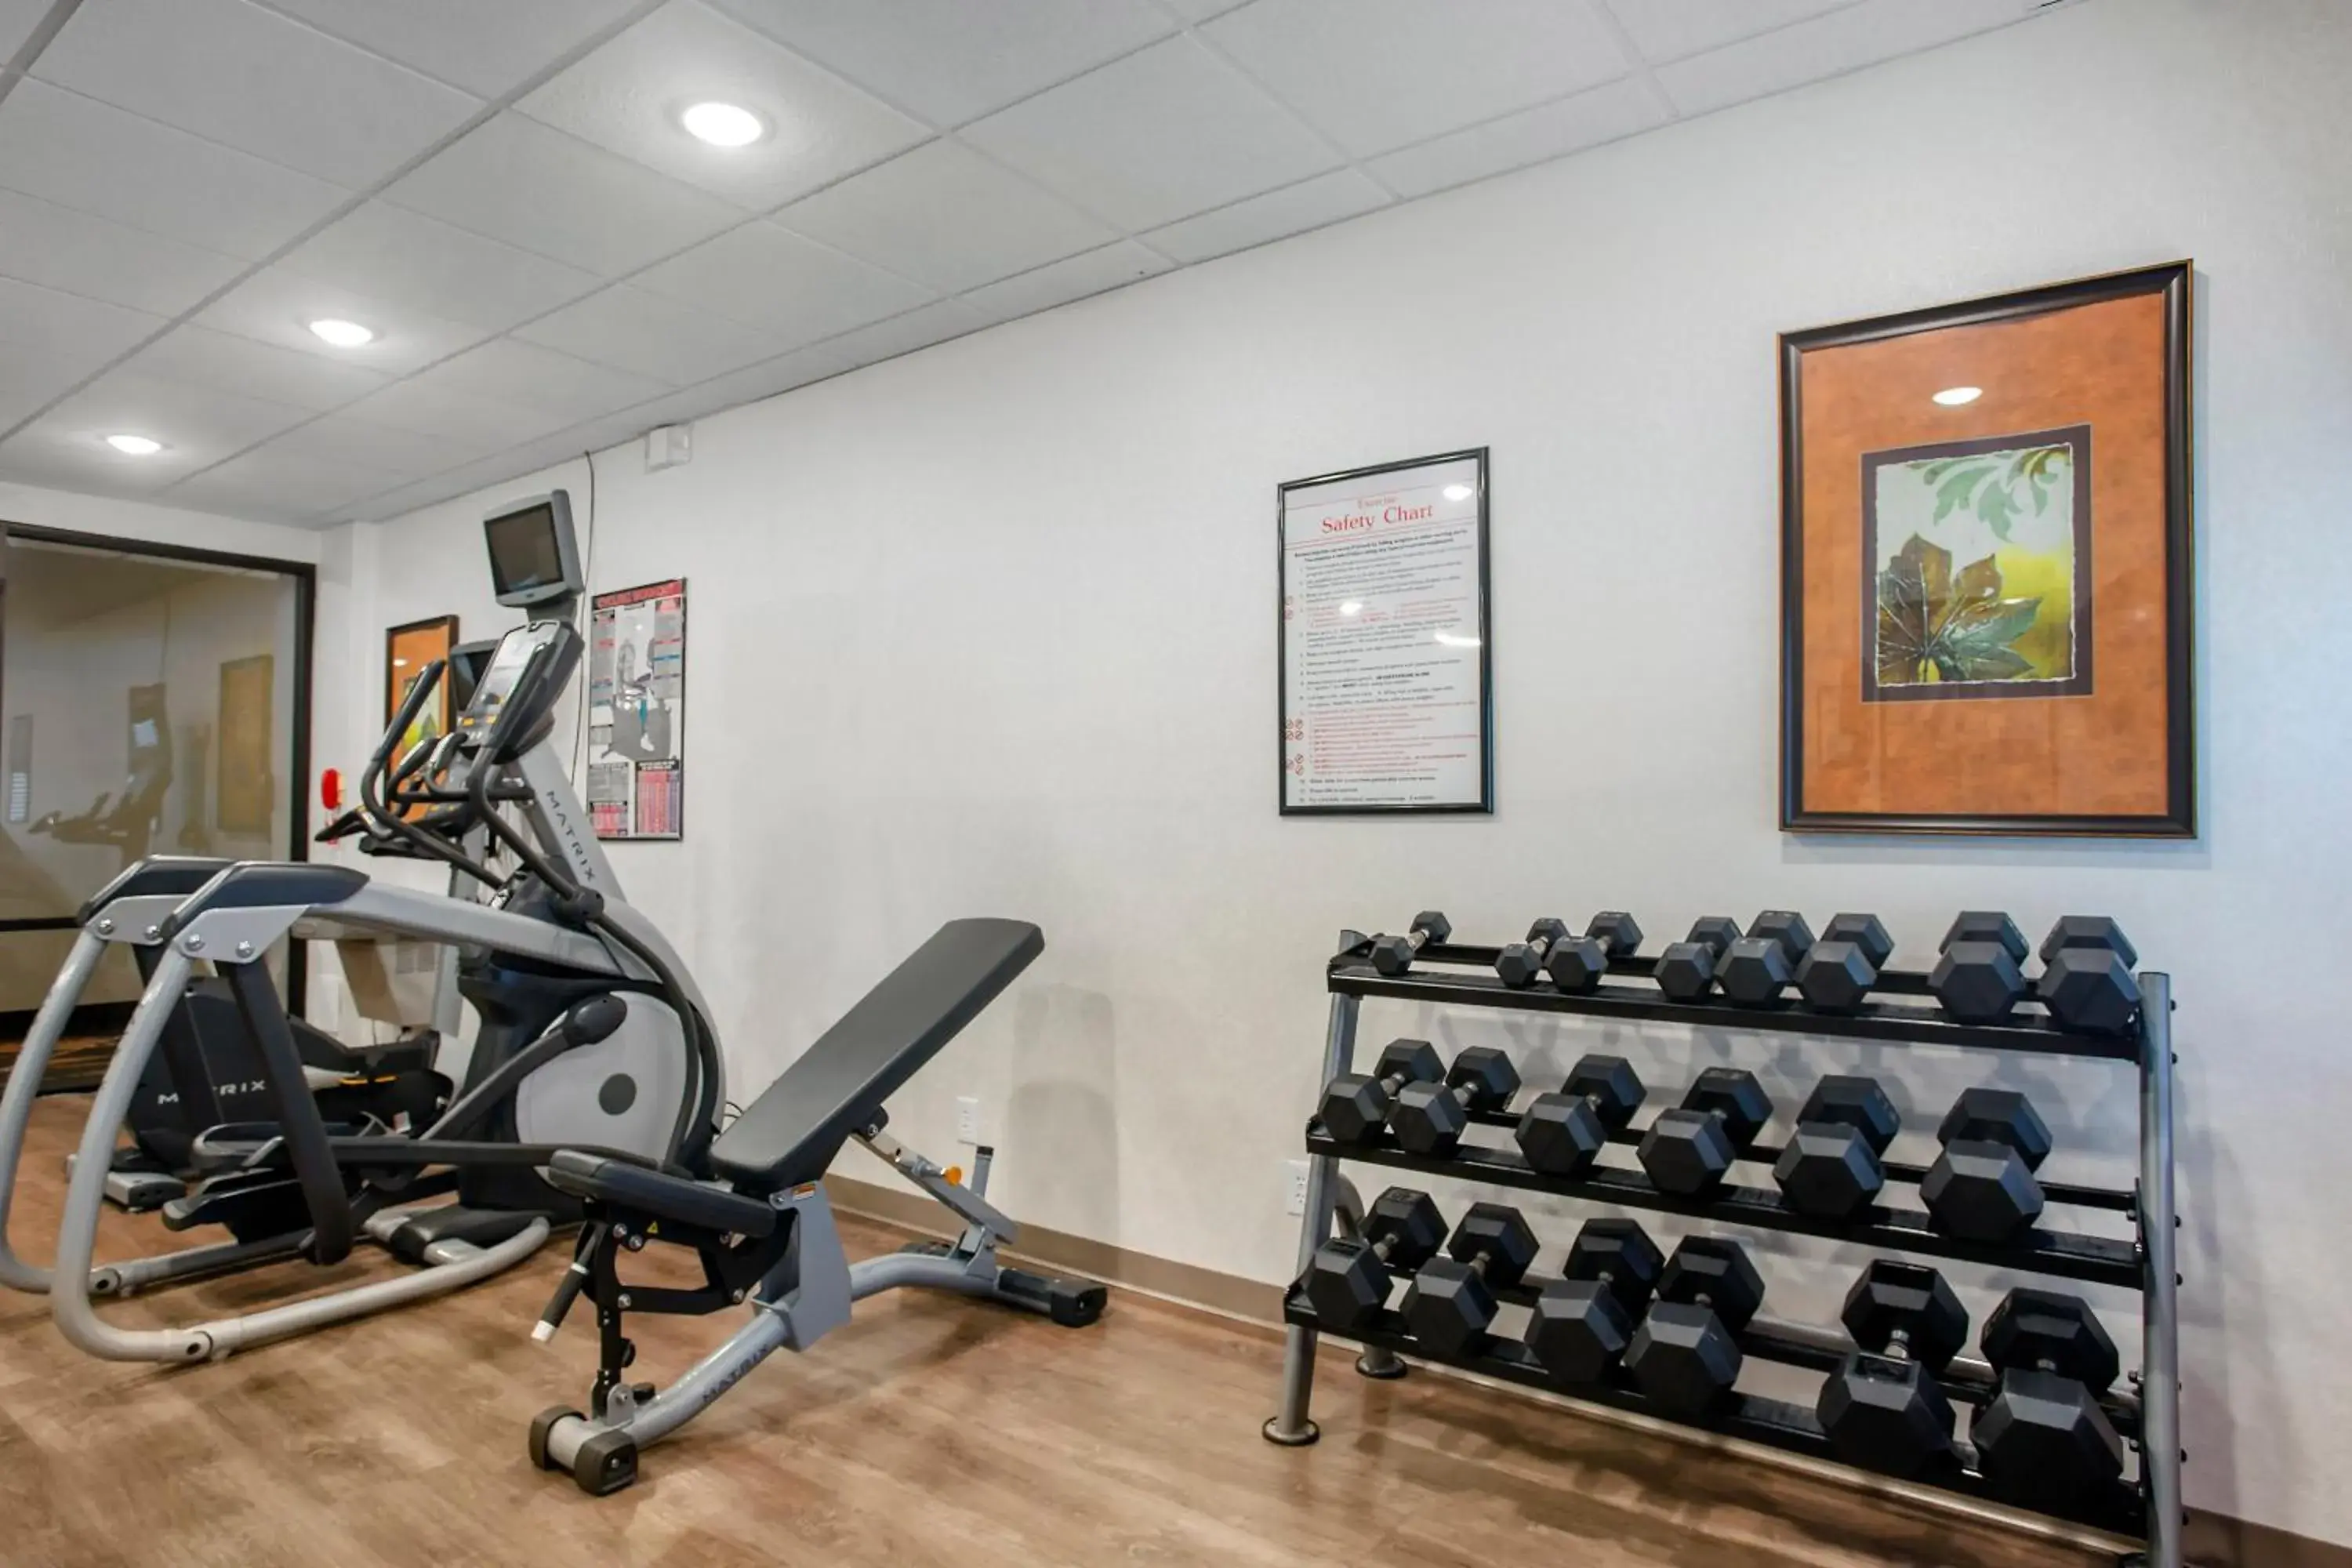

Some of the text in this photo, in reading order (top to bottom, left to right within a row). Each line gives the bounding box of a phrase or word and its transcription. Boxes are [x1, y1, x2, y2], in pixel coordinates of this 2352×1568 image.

[1321, 504, 1433, 534] Safety Chart
[546, 789, 595, 882] MATRIX
[157, 1080, 267, 1105] MRIX
